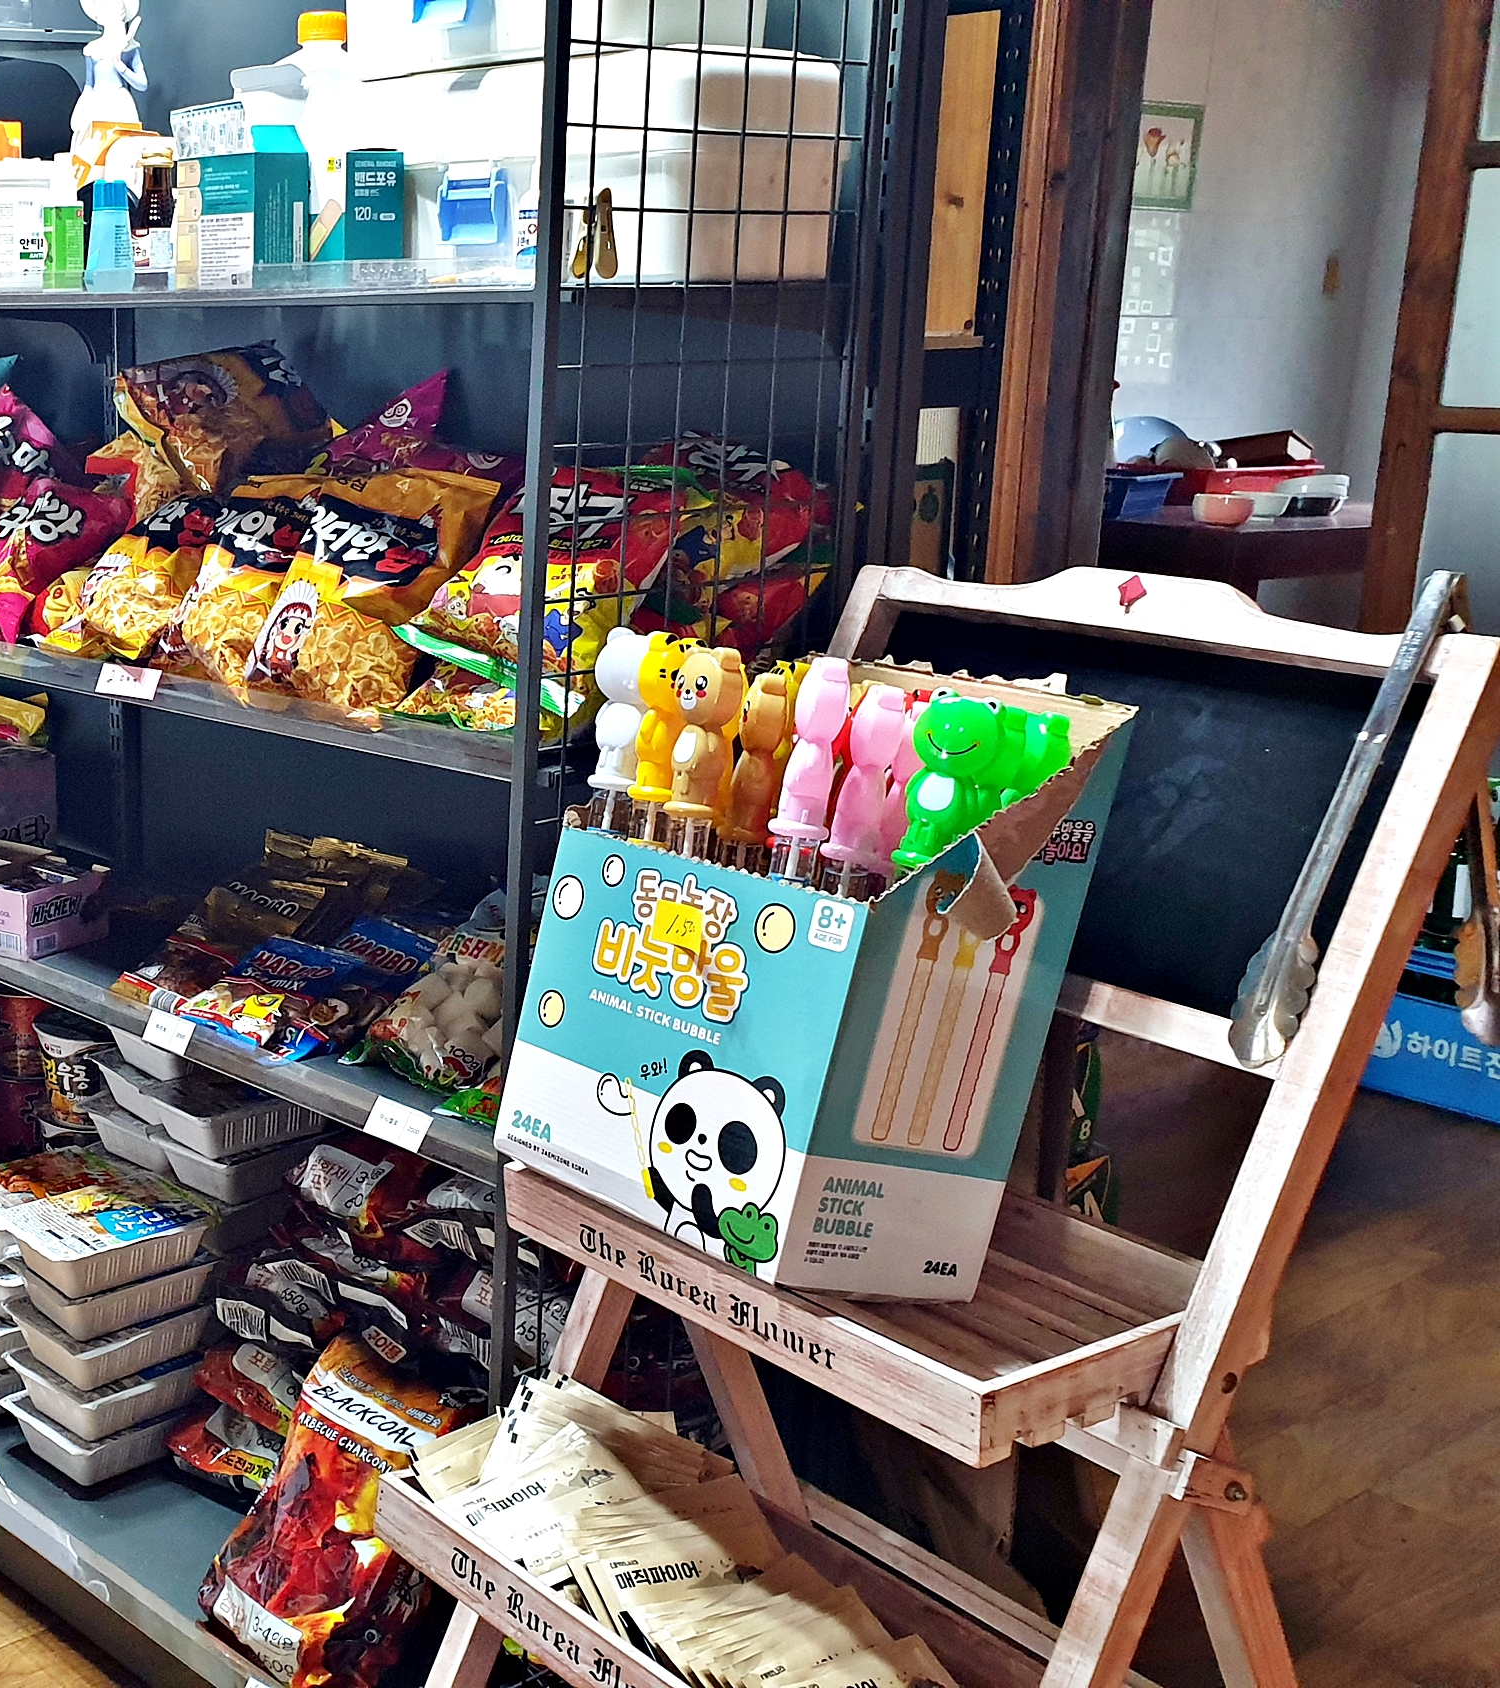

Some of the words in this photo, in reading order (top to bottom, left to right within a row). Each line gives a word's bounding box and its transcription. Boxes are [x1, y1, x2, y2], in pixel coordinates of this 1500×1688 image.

[354, 171, 397, 187] 밴드포유
[354, 206, 371, 221] 120
[30, 894, 82, 928] HI-CHEW
[817, 905, 847, 930] 8+
[336, 932, 420, 977] HARIBO
[813, 932, 828, 944] AGE
[828, 935, 843, 946] FOR
[595, 922, 745, 1018] 비눗방울
[588, 988, 633, 1014] ANIMAL
[635, 1004, 672, 1028] STICK
[672, 1017, 722, 1046] BUBBLE
[448, 1043, 481, 1073] 100g
[639, 1057, 668, 1081] 우와!
[511, 1109, 551, 1143] 24EA
[507, 1132, 532, 1151] DESIGNED
[533, 1144, 541, 1154] BY
[571, 1162, 590, 1177] KOREA
[822, 1175, 885, 1199] ANIMAL
[817, 1196, 866, 1217] STICK
[812, 1216, 874, 1239] BUBBLE
[579, 1223, 627, 1269] The
[922, 1259, 958, 1278] 24EA
[280, 1287, 311, 1315] 650g
[298, 1411, 340, 1442] ARBECUE
[311, 1385, 416, 1448] BLACKCOAL
[465, 1480, 547, 1527] 매직파이어
[450, 1546, 496, 1601] The
[614, 1560, 700, 1591] 매직파이어
